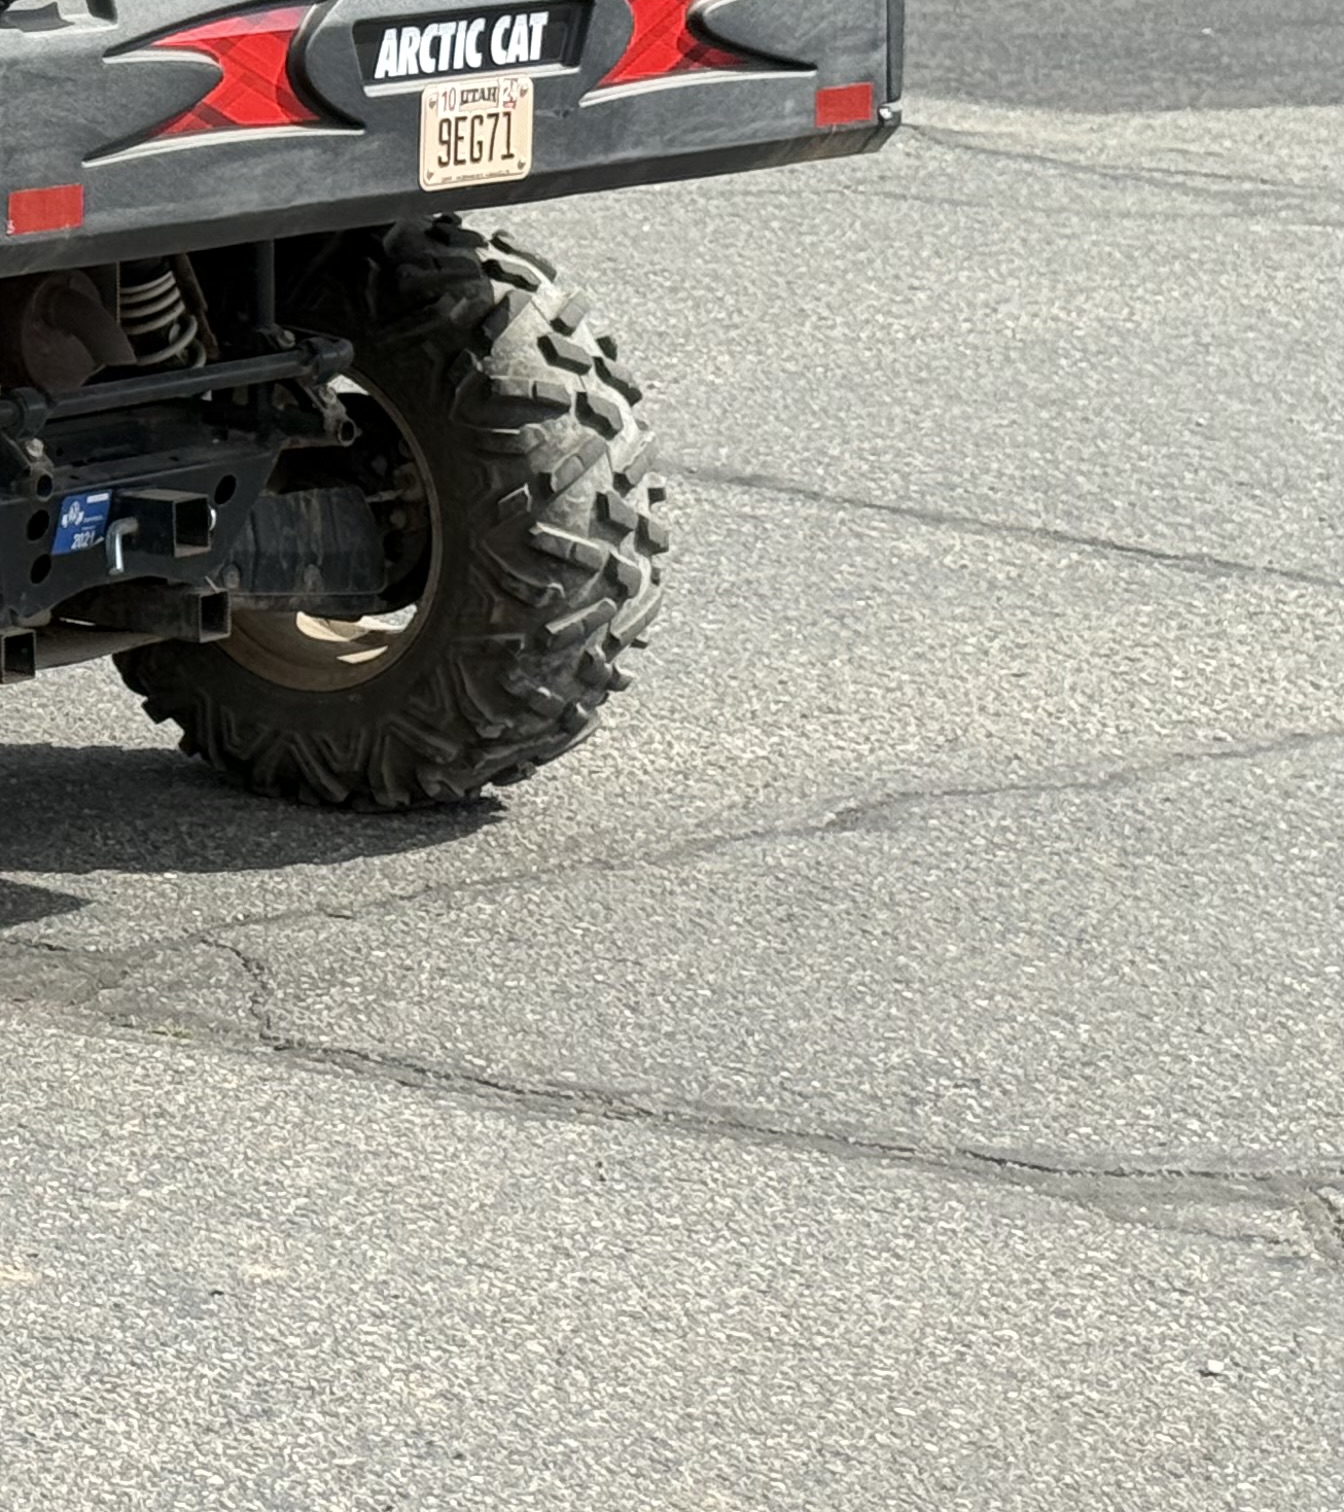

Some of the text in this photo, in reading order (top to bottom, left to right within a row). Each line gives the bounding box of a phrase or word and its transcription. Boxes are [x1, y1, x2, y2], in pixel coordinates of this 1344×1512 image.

[374, 11, 549, 79] ARCTIC CAT
[460, 86, 497, 106] UTAH
[437, 111, 515, 168] 9EG71
